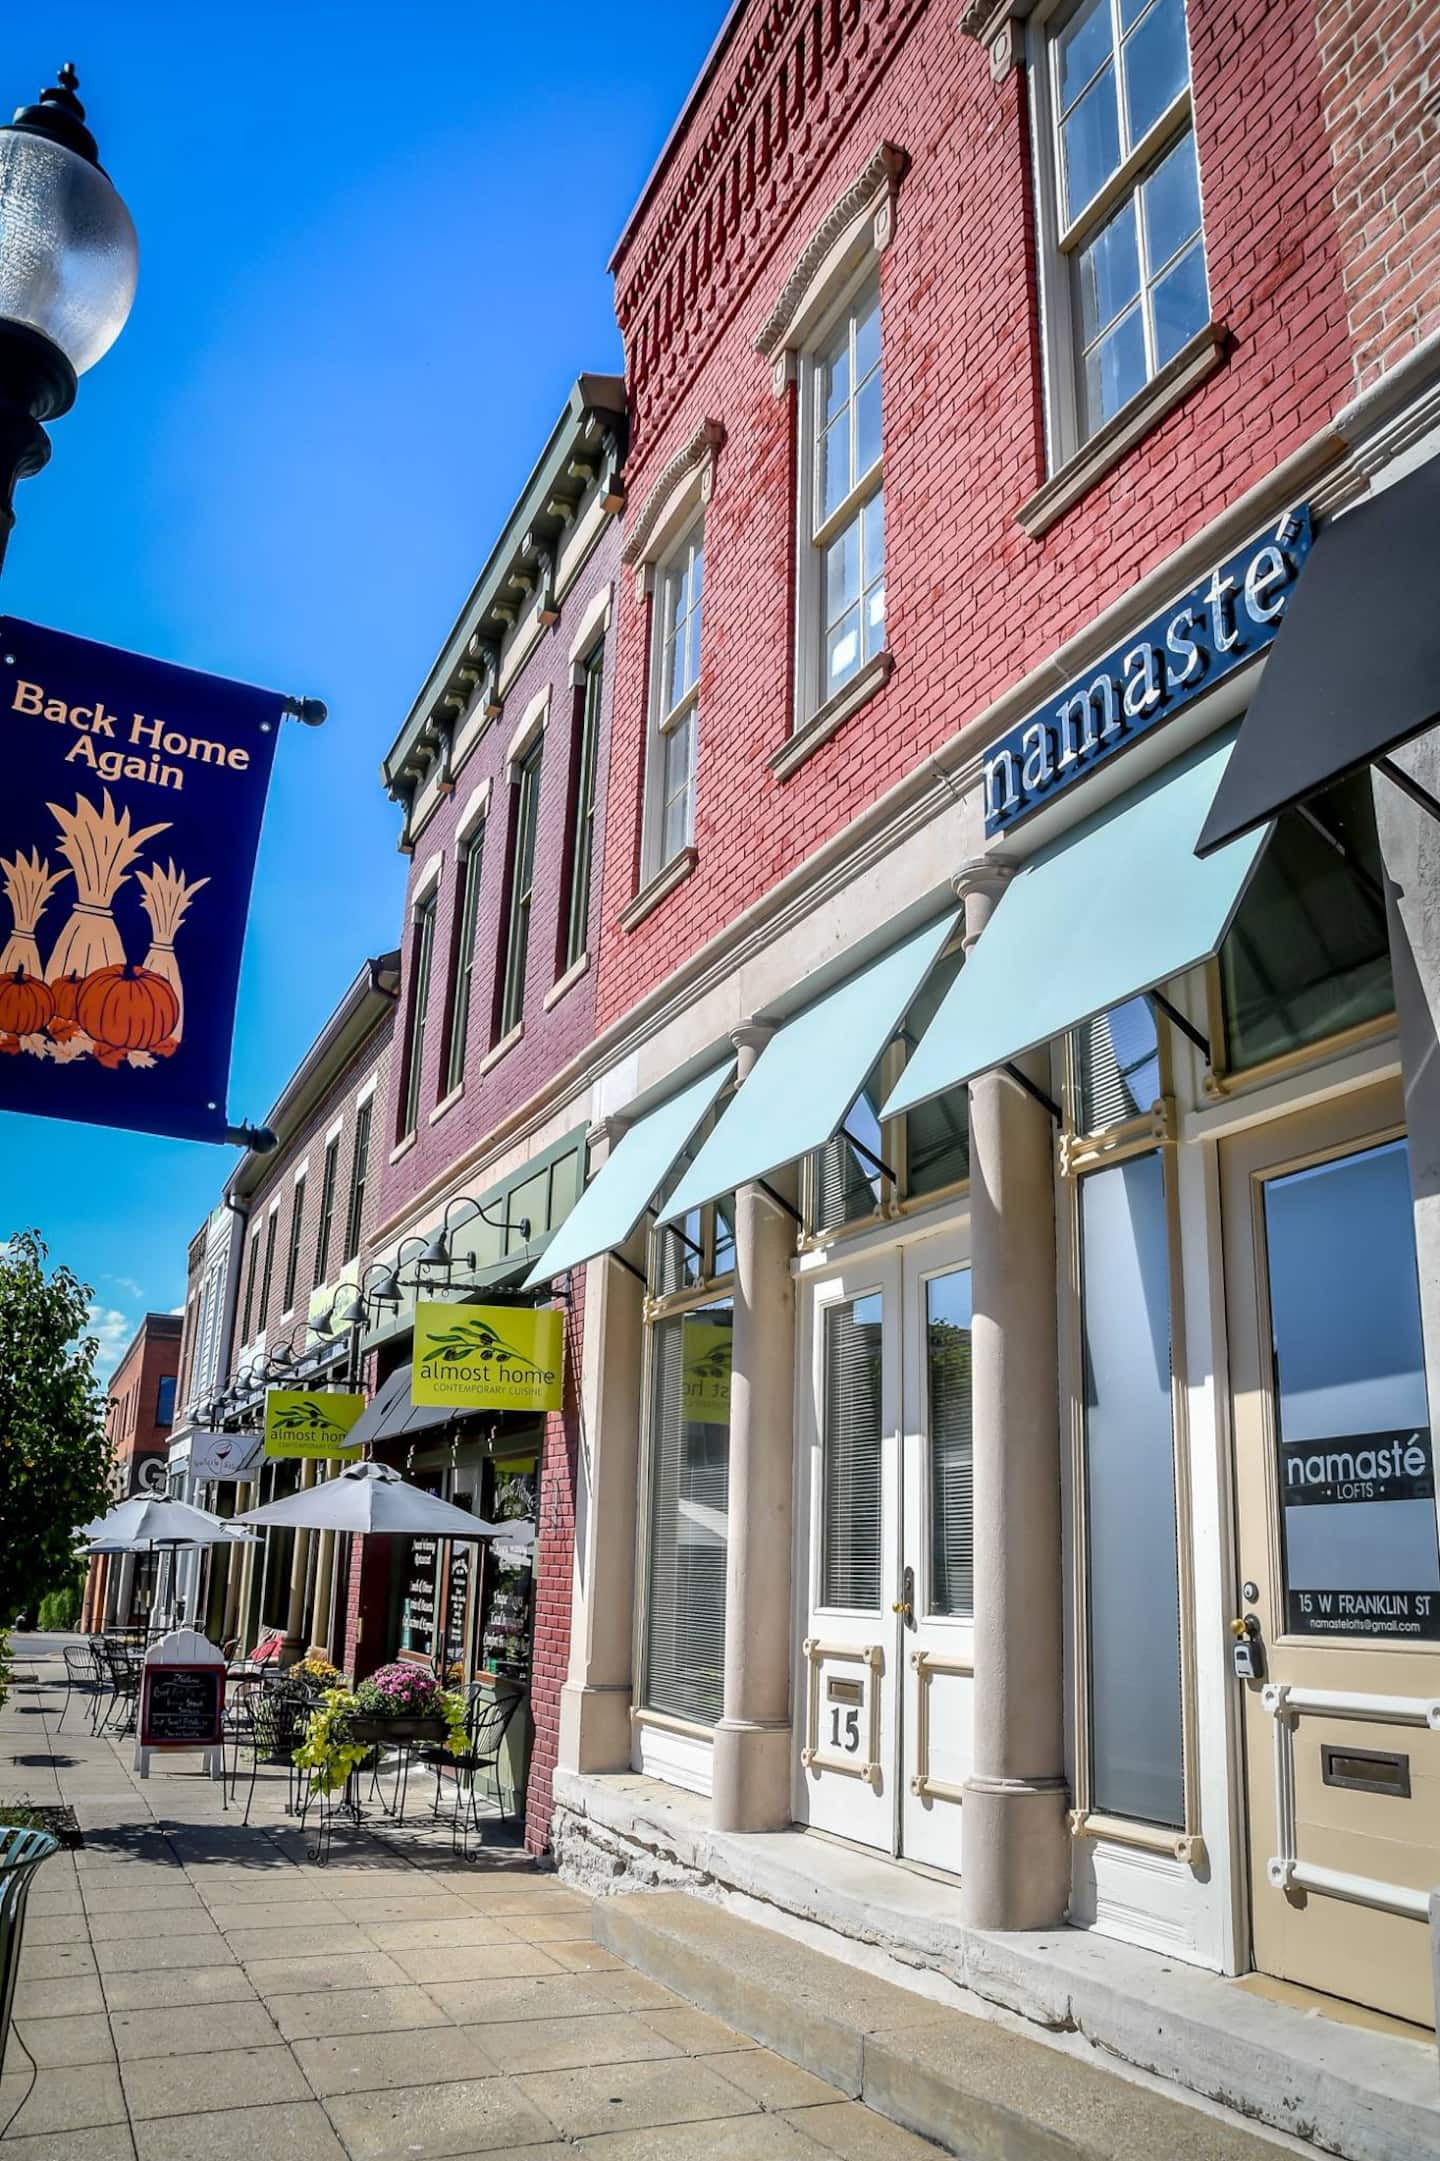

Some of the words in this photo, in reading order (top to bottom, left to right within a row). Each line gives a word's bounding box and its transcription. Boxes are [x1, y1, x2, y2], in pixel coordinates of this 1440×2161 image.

[982, 512, 1293, 820] namasté
[11, 679, 117, 738] Back
[128, 712, 250, 771] Home
[65, 734, 185, 790] Again
[420, 1360, 491, 1382] almost
[499, 1364, 555, 1385] home
[433, 1383, 505, 1394] CONTEMPORARY
[509, 1386, 543, 1396] CUISINE
[270, 1428, 316, 1442] almost
[1287, 1433, 1426, 1485] namasté
[1336, 1481, 1374, 1500] LOFTS
[1298, 1593, 1313, 1613] 15
[1318, 1594, 1333, 1614] W
[1338, 1594, 1409, 1616] FRANKLIN
[1415, 1595, 1431, 1616] ST
[1309, 1618, 1421, 1632] namastelofts@gmail.com
[830, 1707, 859, 1753] 15
